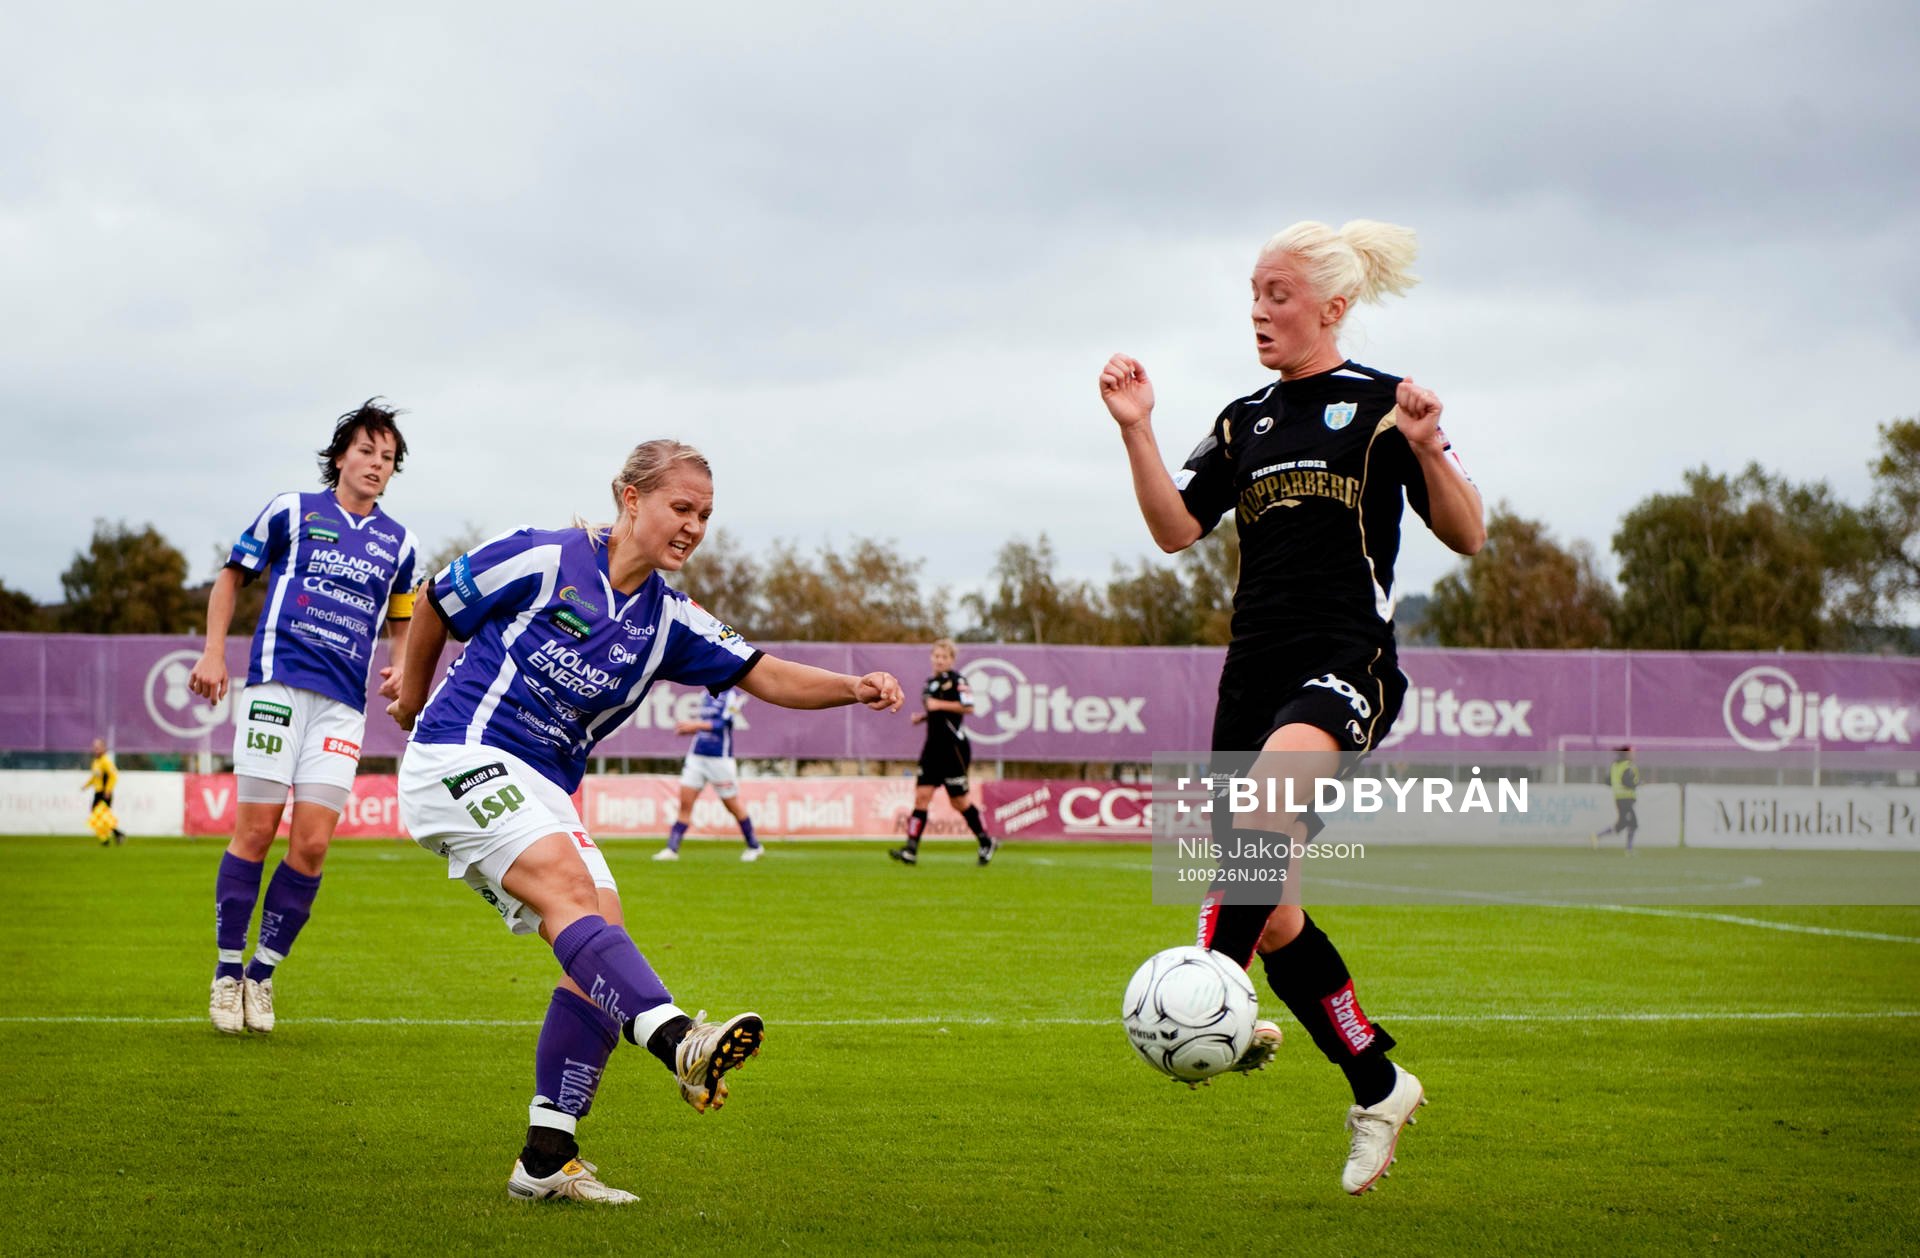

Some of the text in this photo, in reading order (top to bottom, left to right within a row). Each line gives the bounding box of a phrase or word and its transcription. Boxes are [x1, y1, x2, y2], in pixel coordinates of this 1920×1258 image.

[1251, 460, 1327, 479] PREMIUM CIDER
[307, 561, 370, 584] ENERGI
[527, 651, 602, 699] ENERGI
[996, 684, 1146, 733] Jitex
[1390, 686, 1533, 736] Jitex
[1770, 691, 1911, 744] Jitex
[247, 727, 283, 755] isp
[460, 772, 488, 793] MÅLERI
[487, 767, 500, 777] AB
[466, 783, 525, 829] isp
[1714, 799, 1873, 835] Mölndals
